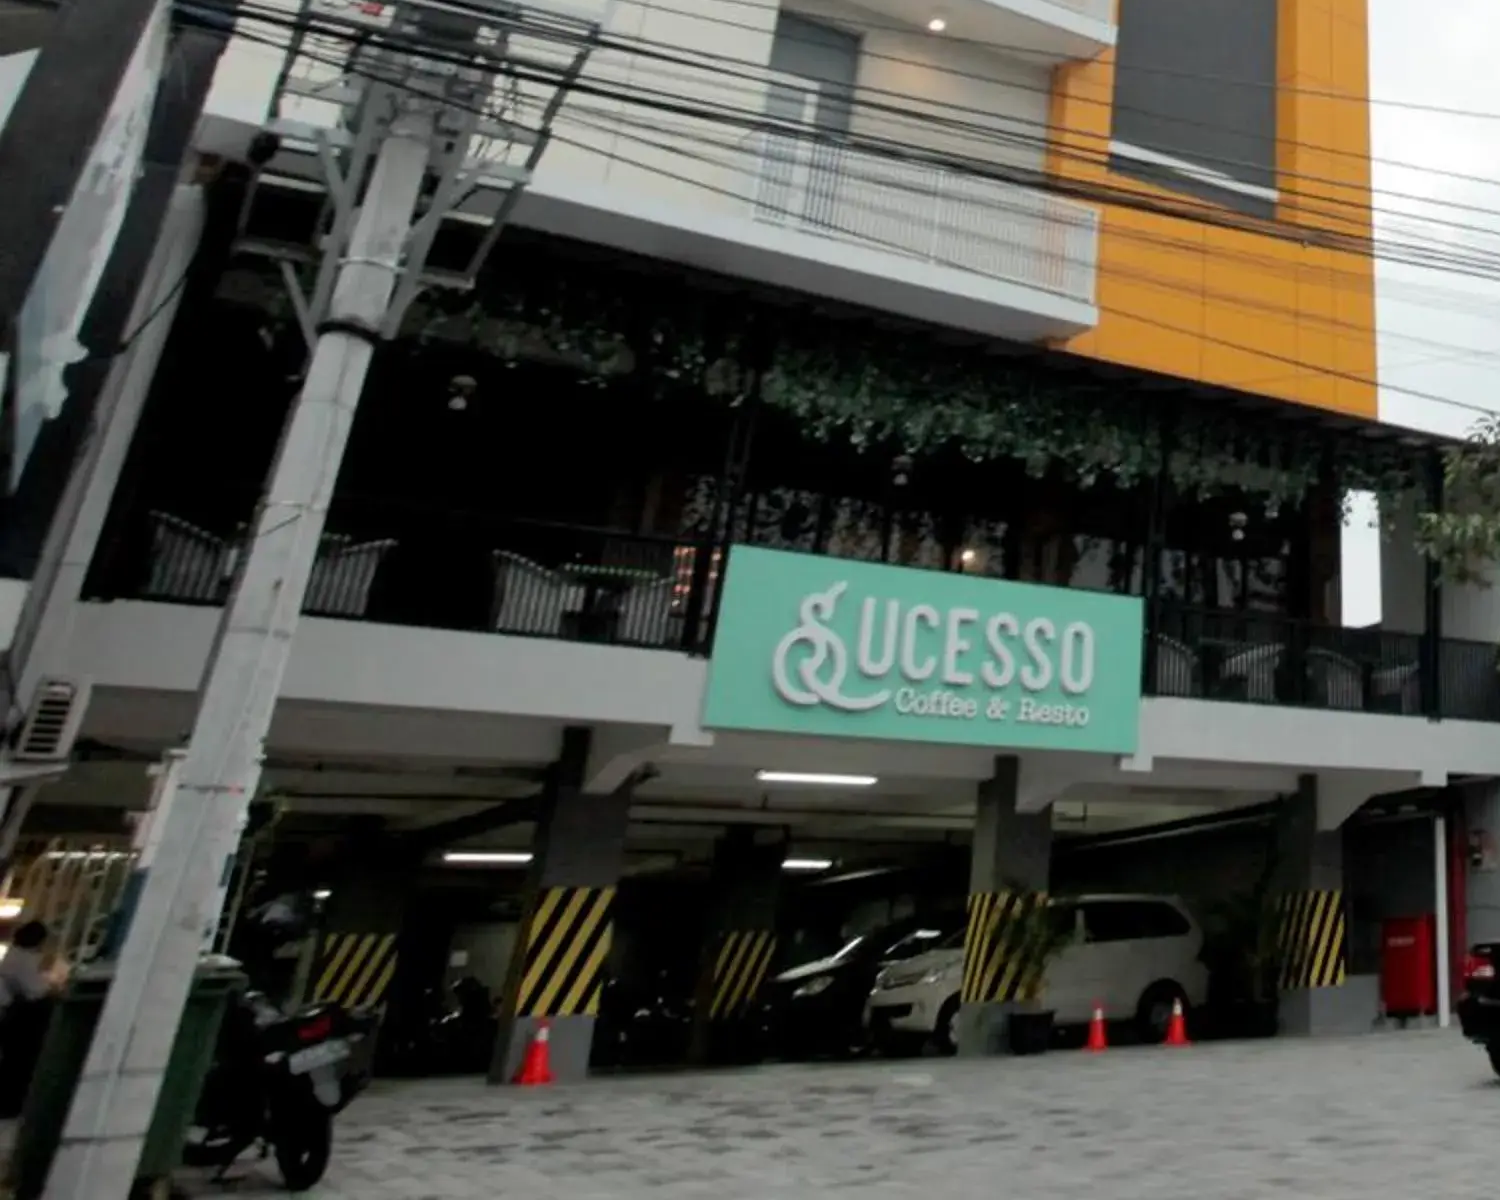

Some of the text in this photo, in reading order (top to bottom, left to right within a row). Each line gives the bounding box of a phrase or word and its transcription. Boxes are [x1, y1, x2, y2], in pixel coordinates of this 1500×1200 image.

[772, 580, 1095, 711] SUCESSO
[895, 688, 1090, 727] Coffee & Resto
